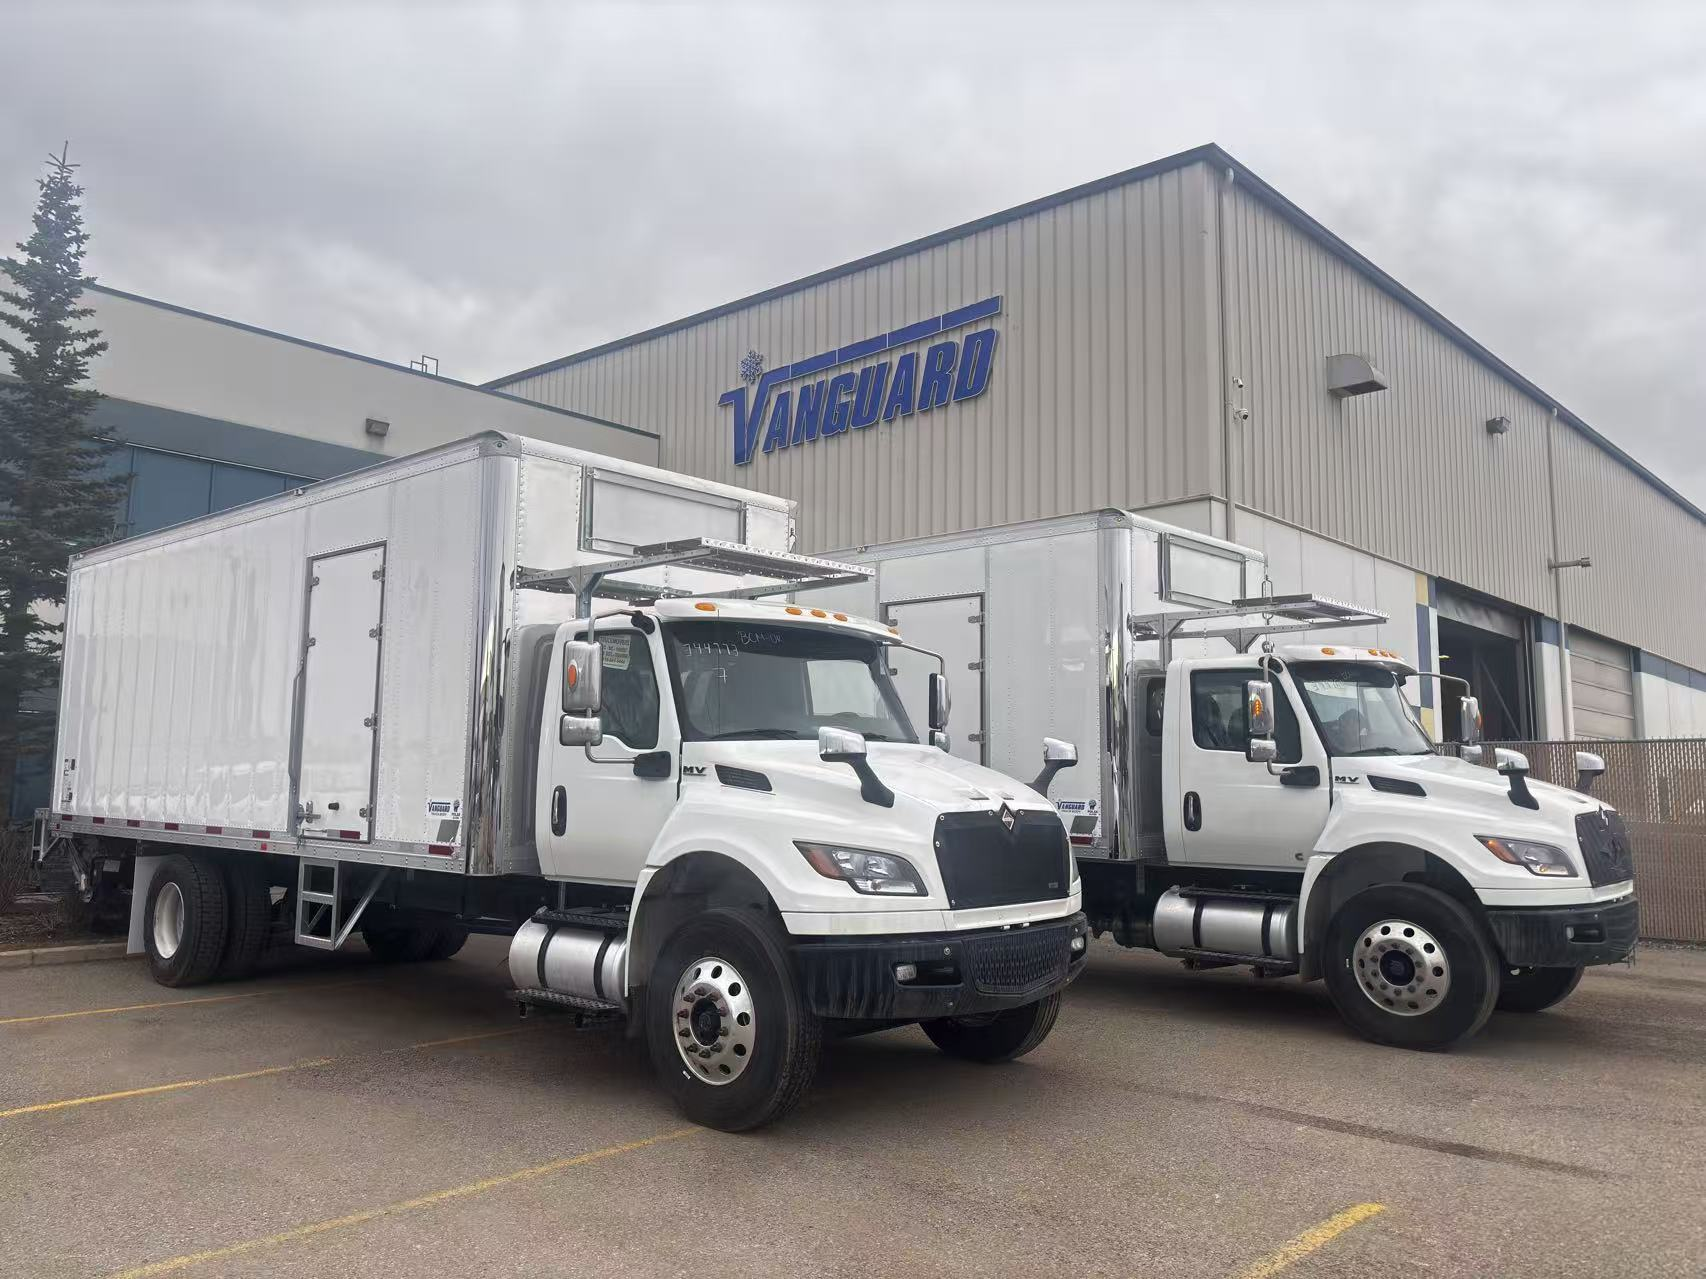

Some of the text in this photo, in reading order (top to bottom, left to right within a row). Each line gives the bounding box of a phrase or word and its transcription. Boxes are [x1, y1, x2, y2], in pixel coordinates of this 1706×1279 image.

[718, 295, 1002, 465] VANGUARD
[683, 765, 707, 774] MV
[1334, 775, 1360, 783] MV
[427, 801, 451, 813] VANGUARD
[1056, 801, 1086, 810] VANGUARD
